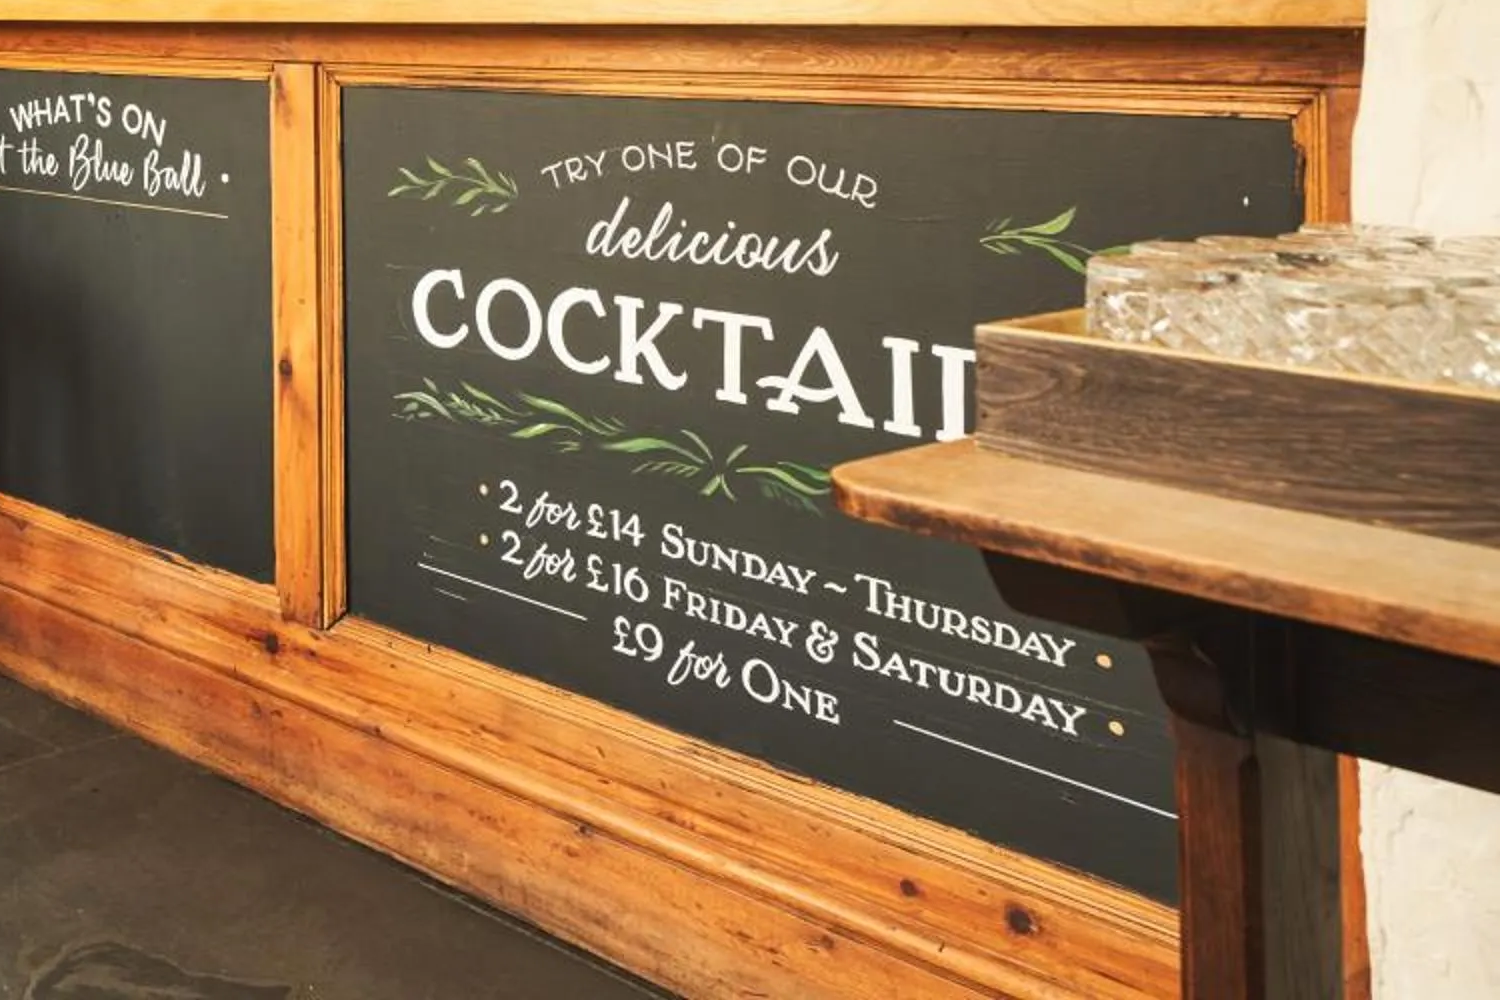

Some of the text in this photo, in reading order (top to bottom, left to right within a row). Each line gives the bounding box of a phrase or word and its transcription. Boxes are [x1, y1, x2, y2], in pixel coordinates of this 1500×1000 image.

[9, 92, 167, 148] WHAT'S ON
[17, 137, 59, 177] the
[68, 133, 136, 191] Blue
[143, 149, 207, 197] Ball
[541, 141, 879, 208] TRY ONE OF OUR
[586, 197, 839, 277] delicious
[499, 480, 523, 514] 2
[525, 491, 581, 530] for
[586, 503, 646, 547] £14
[500, 530, 524, 566] 2
[523, 542, 578, 582] for
[585, 554, 650, 603] £16
[805, 619, 840, 665] &
[612, 615, 664, 662] £9
[667, 639, 731, 688] for
